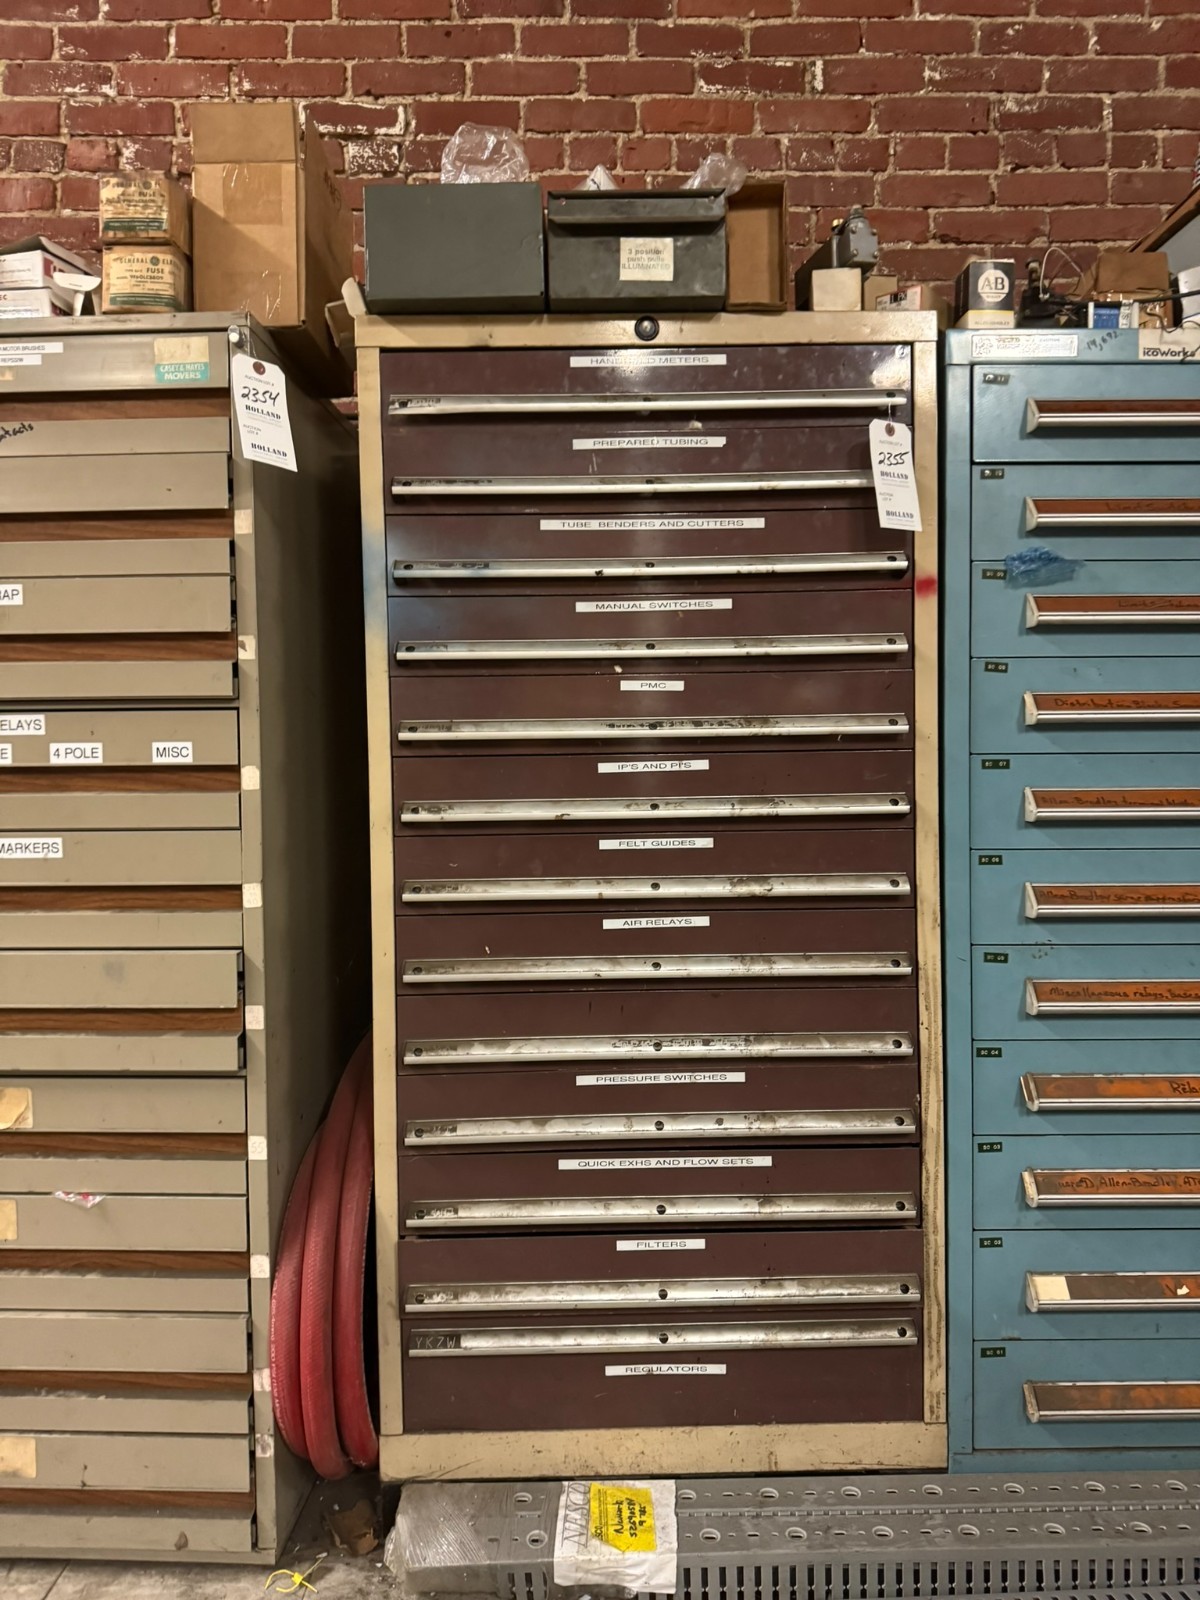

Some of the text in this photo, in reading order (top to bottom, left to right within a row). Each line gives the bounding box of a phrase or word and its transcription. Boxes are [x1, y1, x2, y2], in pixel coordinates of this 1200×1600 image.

[658, 356, 709, 364] METERS
[164, 371, 201, 380] MOVERS
[241, 386, 279, 407] 2354
[245, 404, 281, 420] HOLLAND
[593, 439, 659, 447] PREPARED
[251, 442, 288, 458] HOLLAND
[878, 451, 910, 466] 2355
[880, 470, 909, 480] HOLLAND
[886, 510, 914, 519] HOLLAND
[53, 747, 99, 759] 4 POLE
[156, 747, 189, 758] MISC
[618, 762, 638, 771] IP'S
[625, 1365, 707, 1374] REGULATORS
[563, 1482, 590, 1548] NESCO
